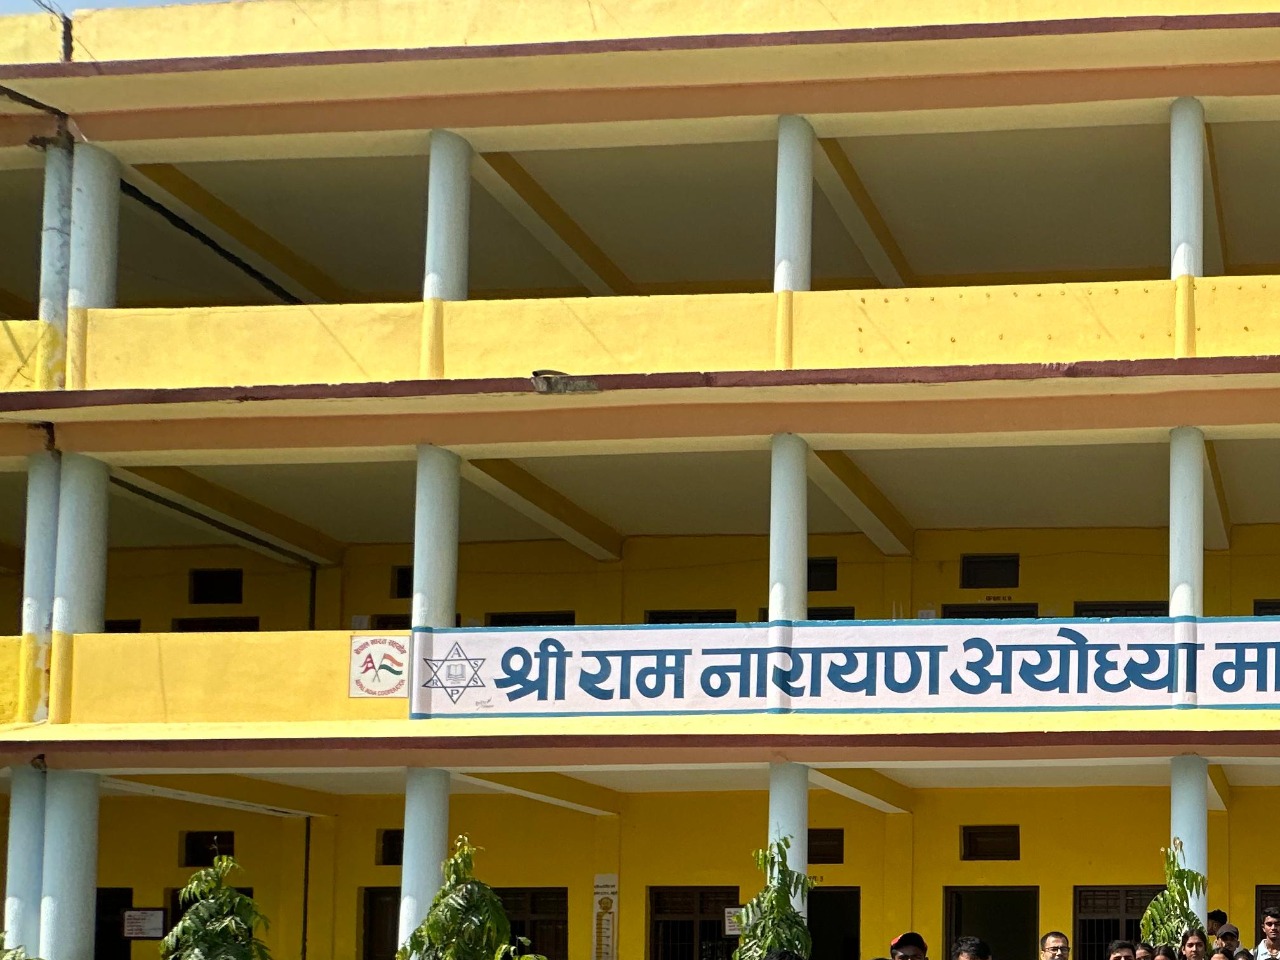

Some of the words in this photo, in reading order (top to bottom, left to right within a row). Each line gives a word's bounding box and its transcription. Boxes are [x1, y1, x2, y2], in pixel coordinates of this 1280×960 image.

[451, 647, 462, 658] A
[473, 660, 480, 669] S
[494, 638, 573, 702] श्री
[579, 648, 692, 700] राम
[701, 646, 948, 700] नारायण
[950, 627, 1204, 695] अयोध्या
[472, 677, 479, 686] S
[450, 689, 460, 698] P
